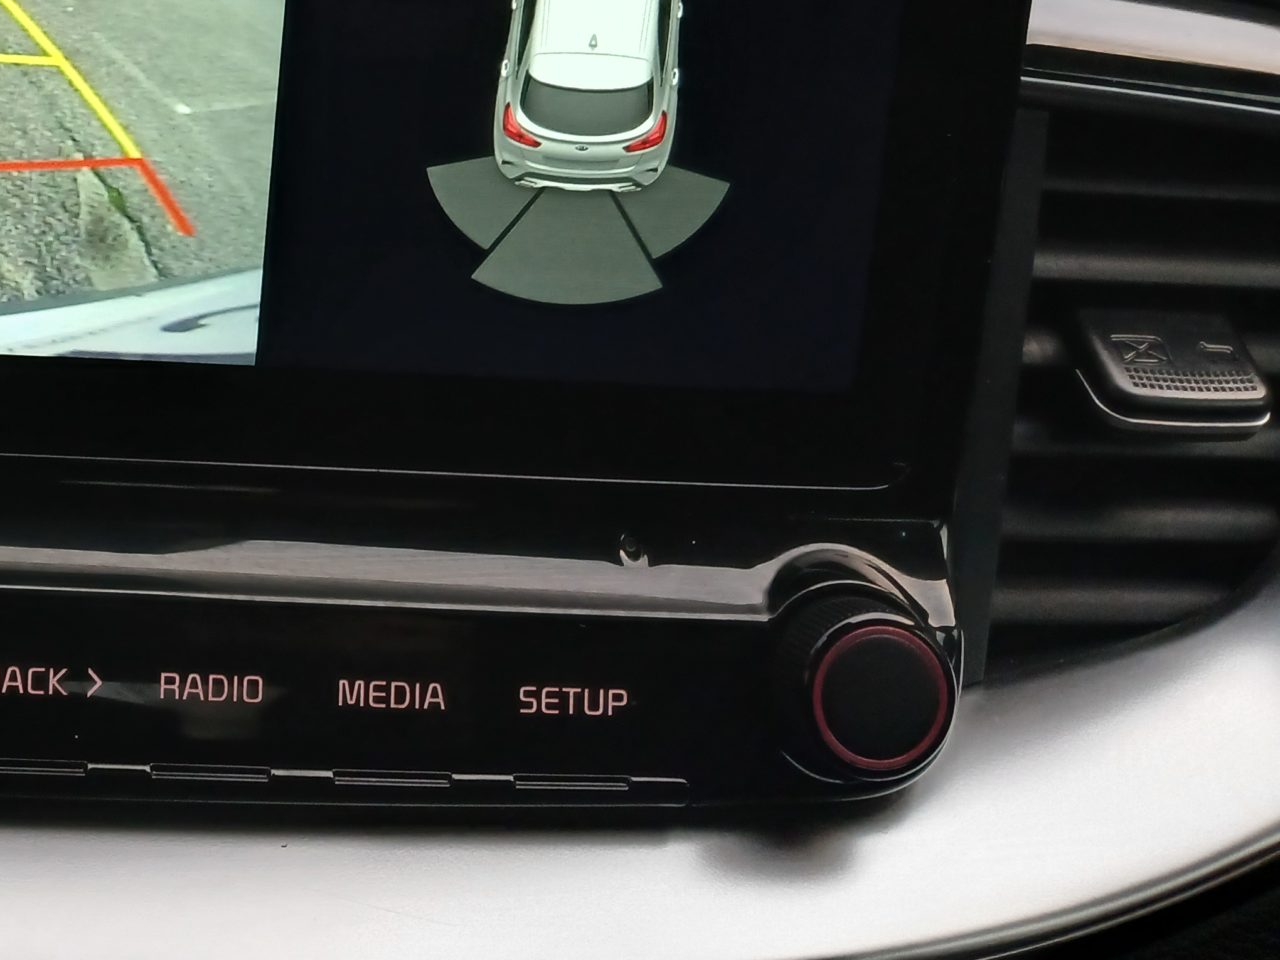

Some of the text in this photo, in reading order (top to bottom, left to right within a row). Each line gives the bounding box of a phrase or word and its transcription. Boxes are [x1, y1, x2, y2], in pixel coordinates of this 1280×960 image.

[158, 672, 264, 703] RADIO
[338, 679, 446, 710] MEDIA
[519, 685, 629, 716] SETUP
